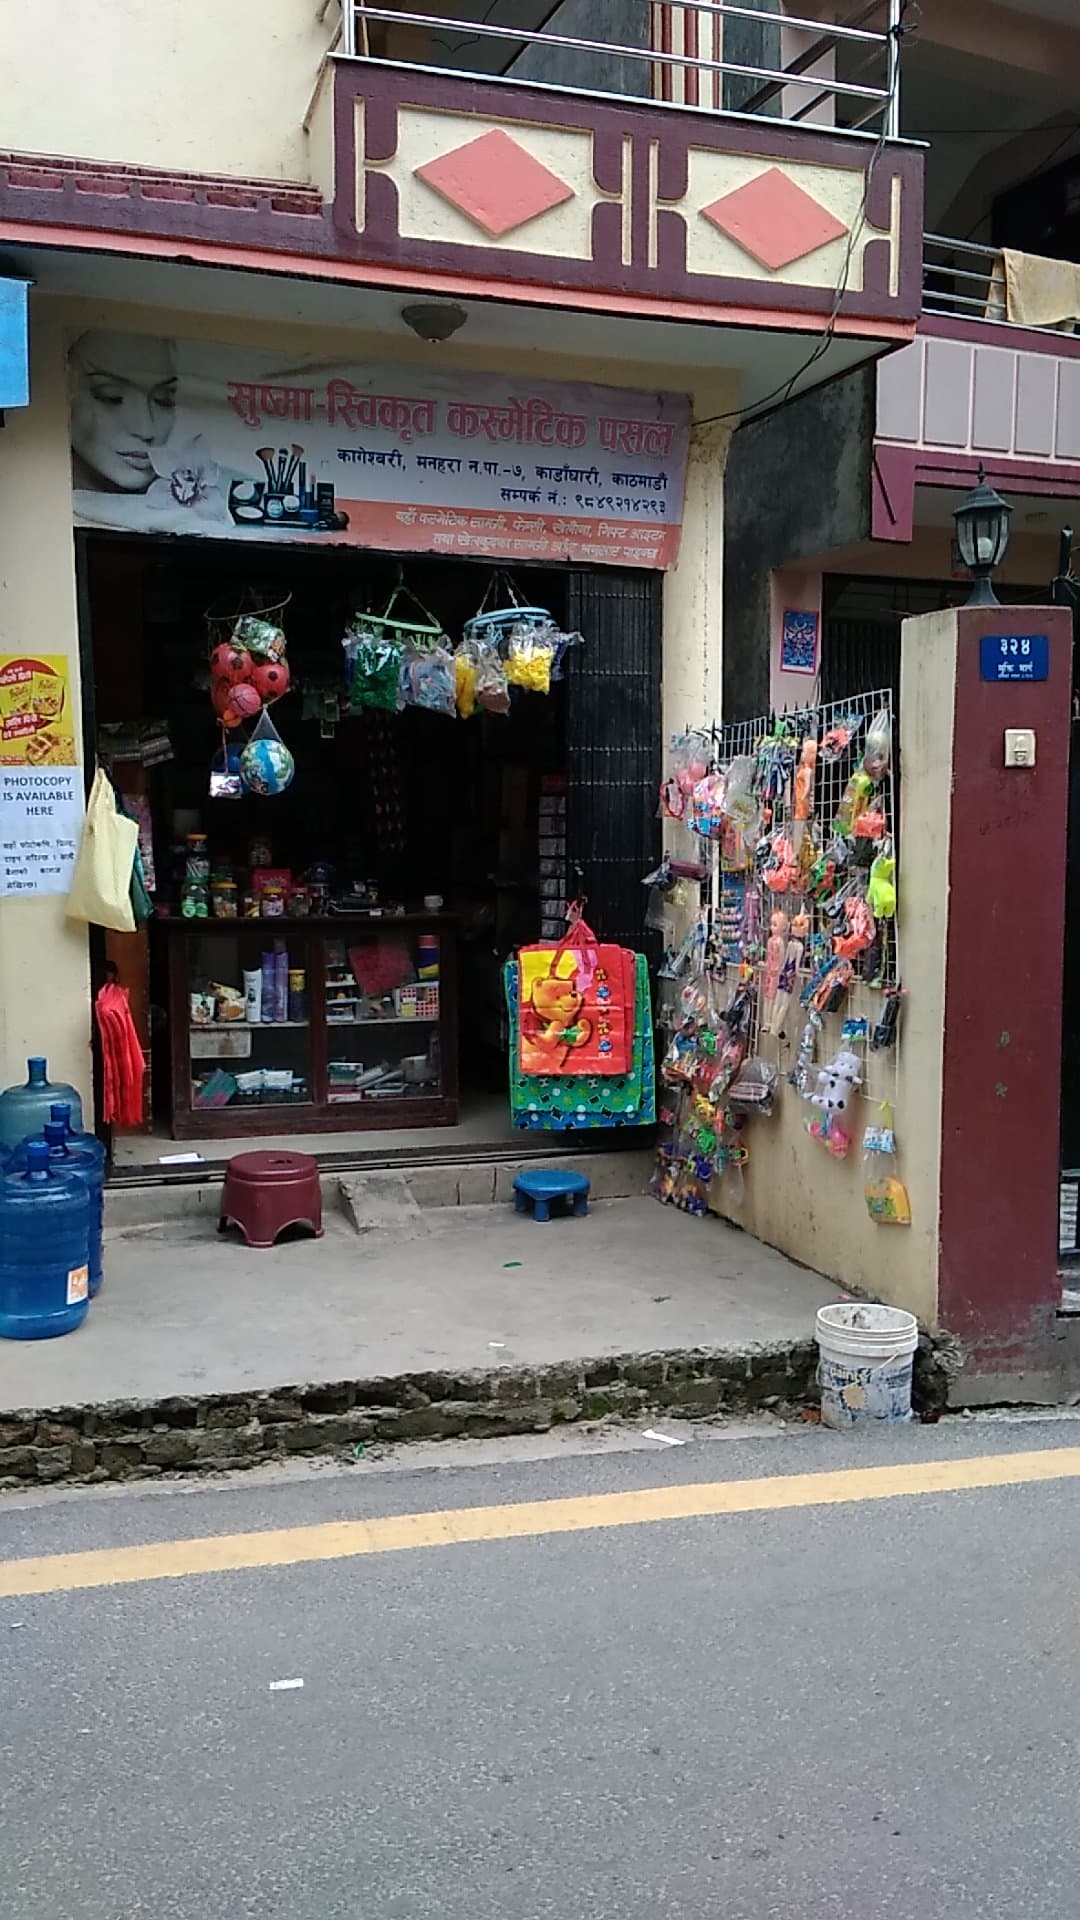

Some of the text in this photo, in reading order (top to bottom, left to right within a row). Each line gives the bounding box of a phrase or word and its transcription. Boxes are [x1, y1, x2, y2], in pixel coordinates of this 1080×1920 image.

[227, 378, 677, 456] सुष्मा-स्विकृत कस्मेटिक पसल
[337, 447, 406, 471] कागेश्वरी,
[416, 456, 461, 473] मनहरा
[500, 486, 541, 503] सम्पर्क
[575, 494, 667, 513] ९८४९२१४२९३
[1000, 638, 1030, 655] ३२४
[4, 776, 72, 786] PHOTOCOPY
[3, 790, 74, 801] IS AVAILABLE
[26, 806, 55, 816] HERE
